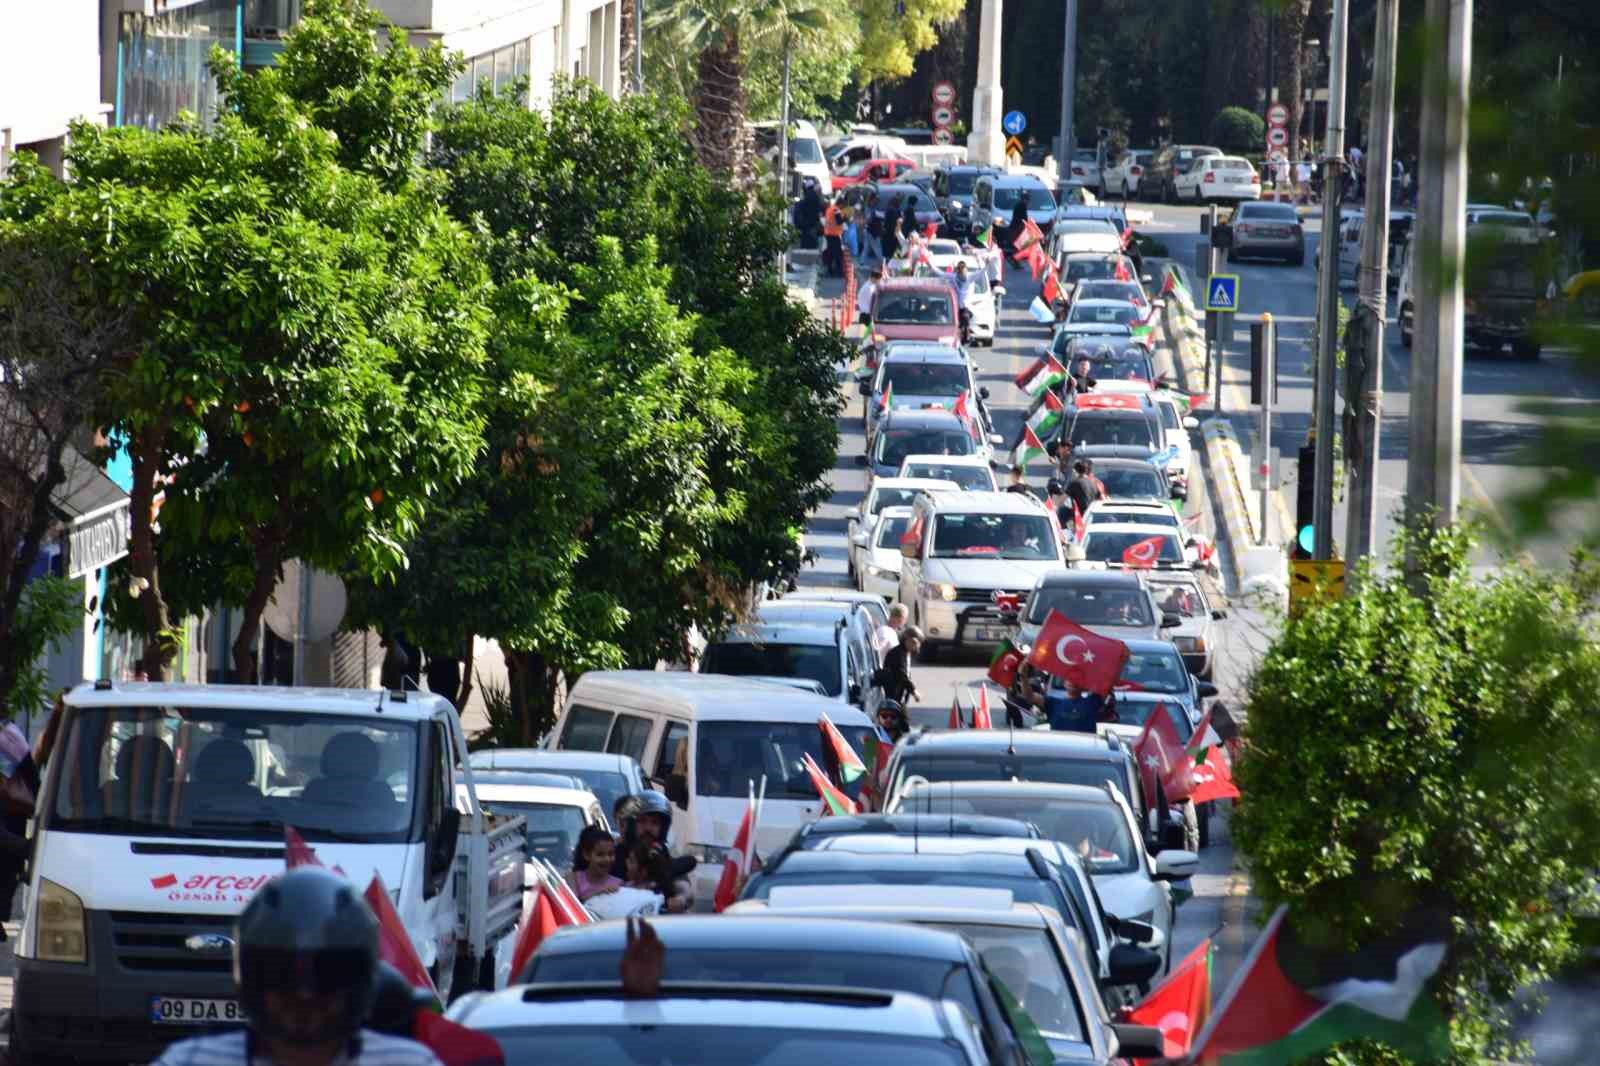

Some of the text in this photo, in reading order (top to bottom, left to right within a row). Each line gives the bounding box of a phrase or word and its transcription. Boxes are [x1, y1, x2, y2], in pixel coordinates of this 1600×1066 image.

[183, 874, 269, 893] arçel
[161, 1000, 185, 1018] 09
[192, 1001, 219, 1019] DA
